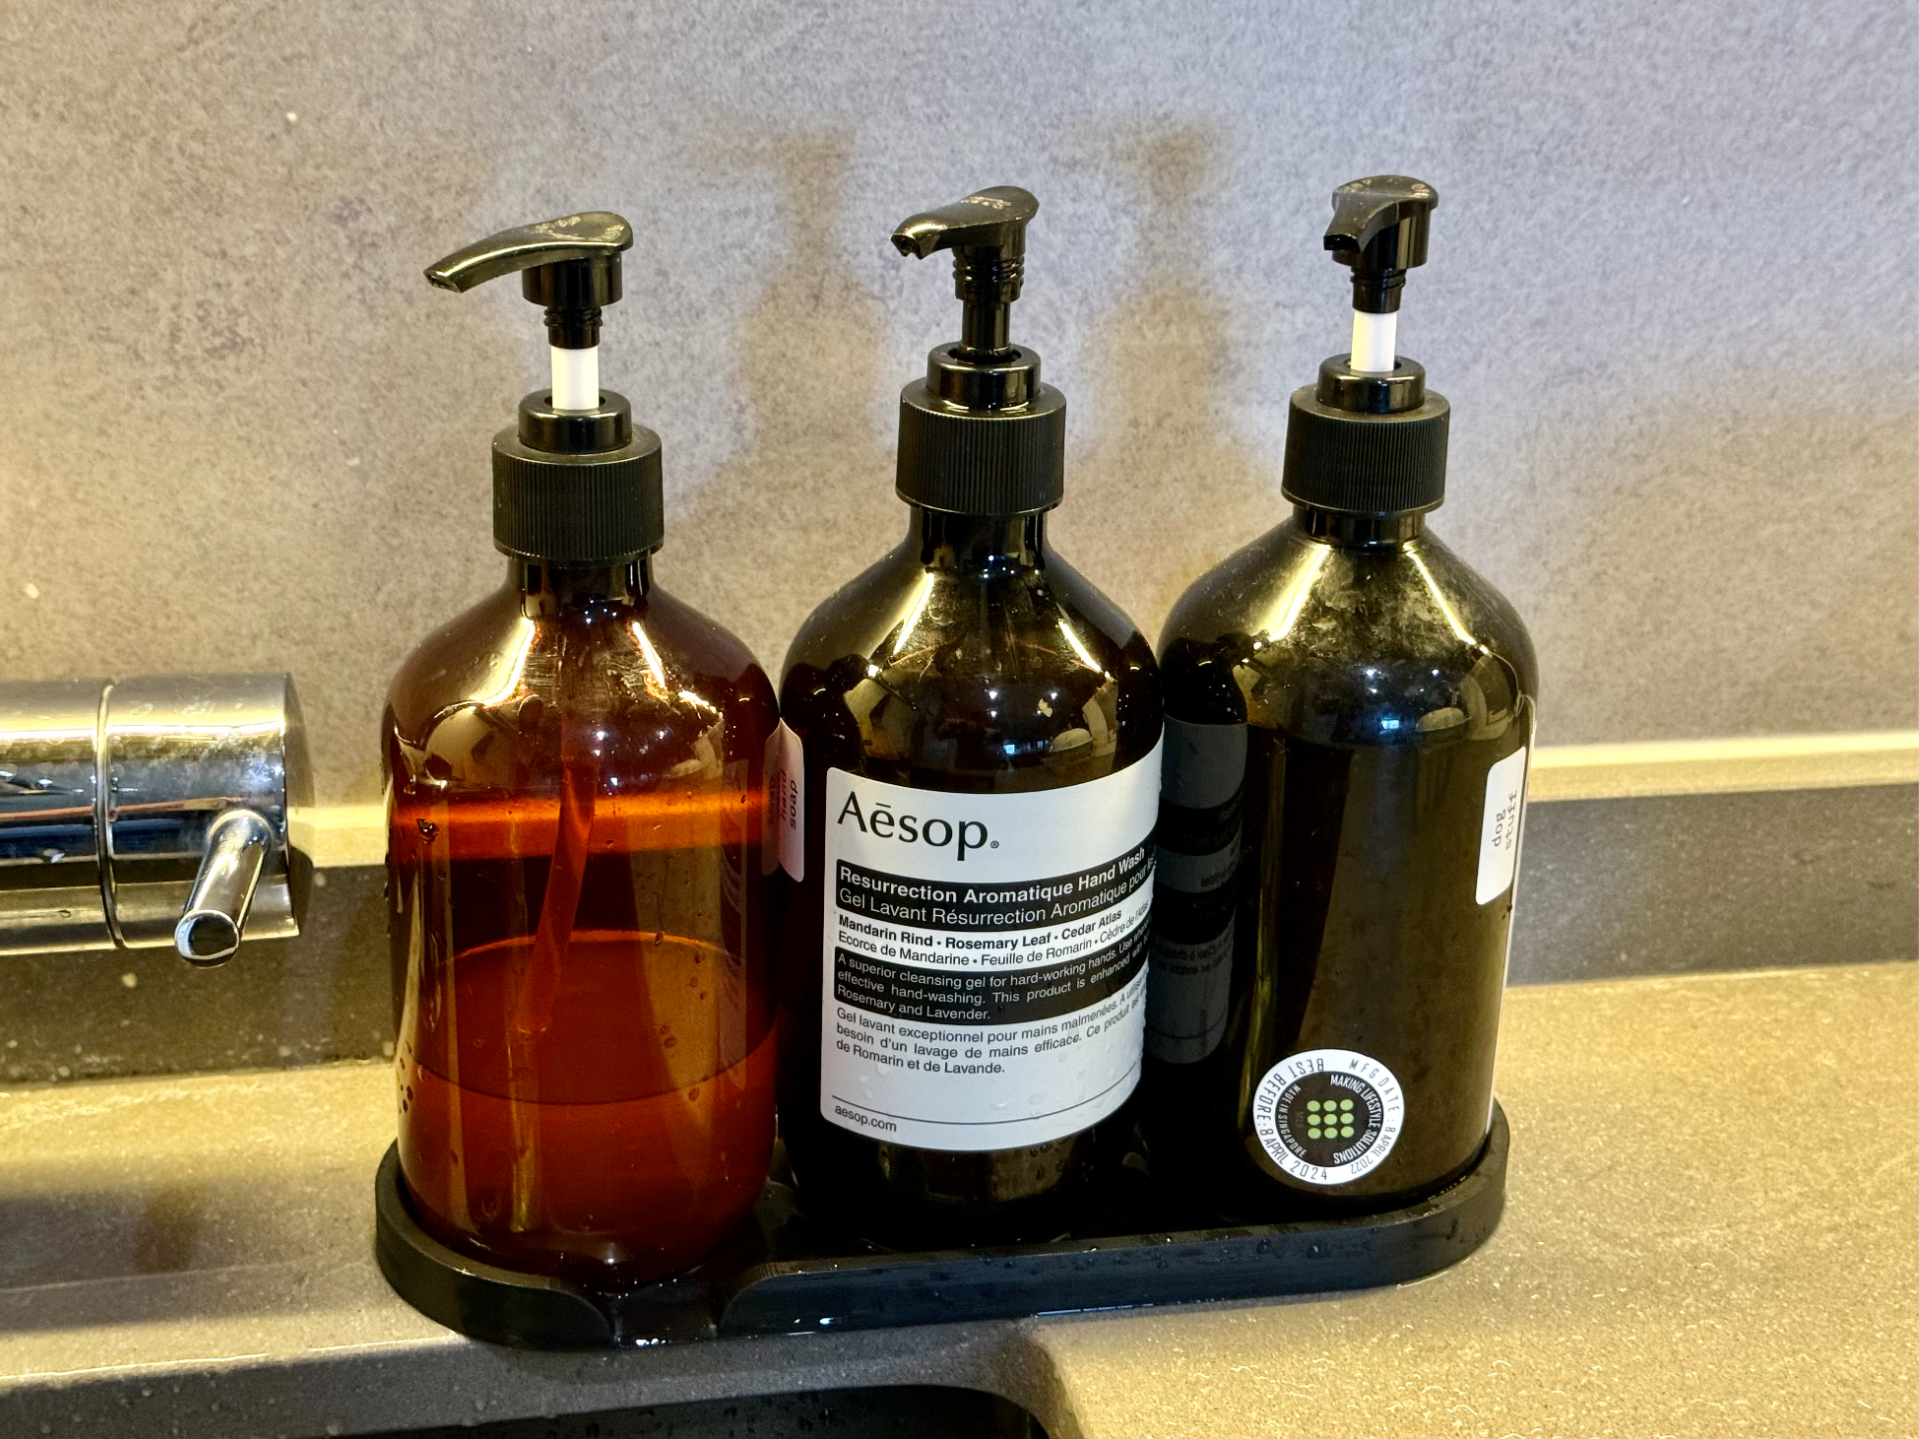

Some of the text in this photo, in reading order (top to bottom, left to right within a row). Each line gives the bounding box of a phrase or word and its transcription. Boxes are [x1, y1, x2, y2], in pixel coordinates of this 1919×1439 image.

[790, 780, 798, 830] soap
[1505, 790, 1517, 850] stuff
[1492, 808, 1506, 847] dog
[839, 888, 865, 908] Gel
[870, 897, 926, 921] Lavant
[932, 908, 1046, 925] Résurrection
[1051, 881, 1127, 918] Aromatique
[1129, 864, 1146, 892] pour
[840, 847, 1144, 903] Resurrection Aromatique Hand Wash
[839, 910, 1122, 951] Mandarin Rind Rosemary Leaf Cedar Atlas
[839, 930, 877, 952] Ecorce
[881, 945, 896, 957] de
[900, 948, 969, 965] Mandarine
[981, 953, 1023, 965] Feuille
[1027, 951, 1042, 962] de
[1046, 939, 1092, 959] Romarin
[1099, 921, 1125, 943] Cèdre
[1125, 915, 1134, 929] de
[838, 953, 846, 965] A
[849, 958, 896, 979] superior
[900, 970, 961, 989] cleansing
[966, 977, 985, 990] gel
[989, 976, 1007, 987] for
[1010, 961, 1086, 986] hard-working
[1089, 949, 1116, 969] hands.
[1118, 935, 1133, 953] Use
[838, 971, 884, 992] effective
[892, 984, 986, 1006] hand-washing.
[993, 991, 1019, 1003] This
[1026, 982, 1071, 1003] product
[1076, 978, 1085, 989] is
[1091, 956, 1130, 983] enhanced
[837, 1007, 855, 1023] Gel
[859, 1015, 895, 1034] lavant
[899, 1026, 983, 1042] exceptionnel
[988, 1031, 1018, 1044] pour
[1022, 1025, 1058, 1038] mains
[1061, 1003, 1117, 1031] malmenées.
[1118, 993, 1125, 1005] A
[838, 984, 990, 1019] Rosemary and Lavender.
[837, 1022, 874, 1044] besoin
[881, 1038, 907, 1052] d'un
[914, 1043, 957, 1059] lavage
[965, 1049, 982, 1058] de
[989, 1045, 1028, 1058] mains
[1034, 1034, 1082, 1052] efficace.
[1087, 1025, 1100, 1037] Ce
[1104, 1003, 1129, 1032] produit
[836, 1039, 1005, 1074] de Romarin et de Lavande.
[1288, 1058, 1324, 1078] BEST
[1349, 1059, 1379, 1079] MFG
[1285, 1084, 1301, 1103] MADE
[835, 1105, 897, 1132] aesop.com
[1278, 1114, 1307, 1158] SINGAPORE
[1330, 1075, 1381, 1164] MAKING LIFESTYLE SOLUTIONS
[1264, 1138, 1289, 1165] APRIL
[1350, 1155, 1373, 1174] 2022
[1375, 1135, 1392, 1157] APRIL
[1290, 1160, 1327, 1180] 2024
